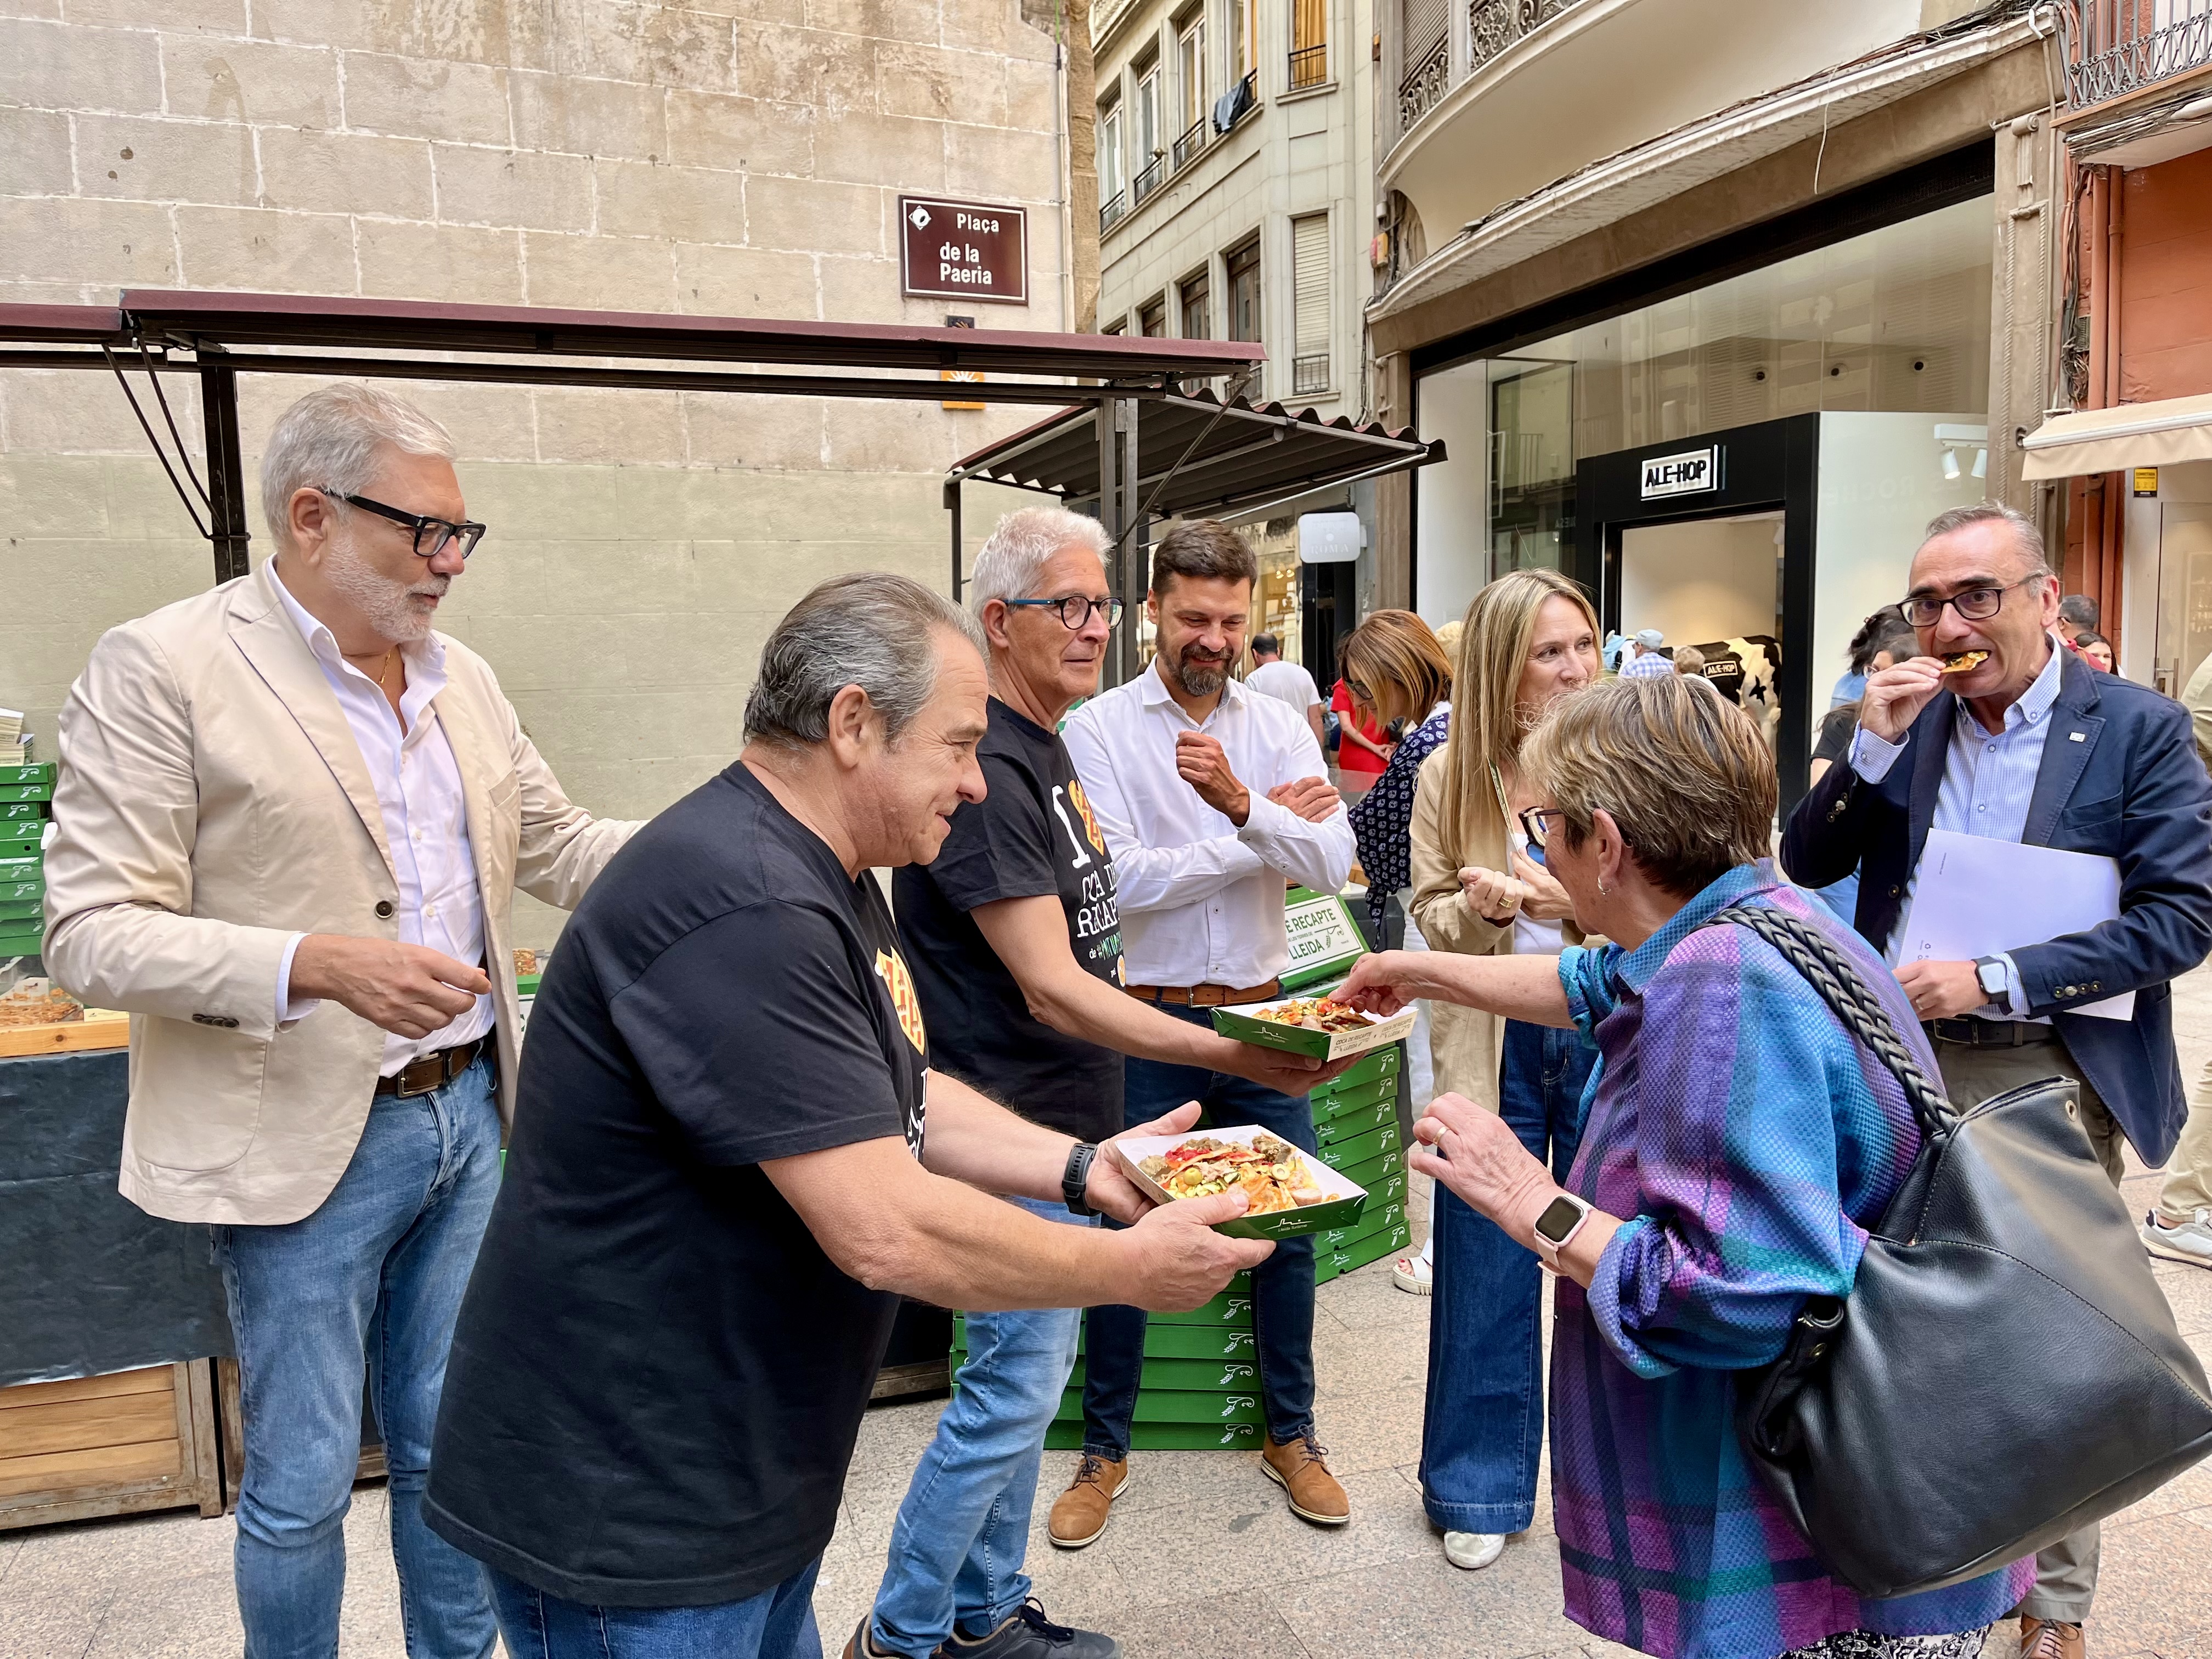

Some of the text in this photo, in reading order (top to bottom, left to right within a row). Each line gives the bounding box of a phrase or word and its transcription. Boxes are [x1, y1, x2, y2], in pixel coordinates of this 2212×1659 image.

[957, 213, 1000, 233] Plaça
[939, 241, 980, 263] de la
[940, 262, 992, 285] Paeria
[1645, 460, 1707, 487] ALE-HOP
[1311, 544, 1348, 555] ROMA
[1708, 664, 1735, 675] ALE-HOP
[1285, 908, 1336, 933] E RECAPTE
[1288, 939, 1325, 960] LLEIDA
